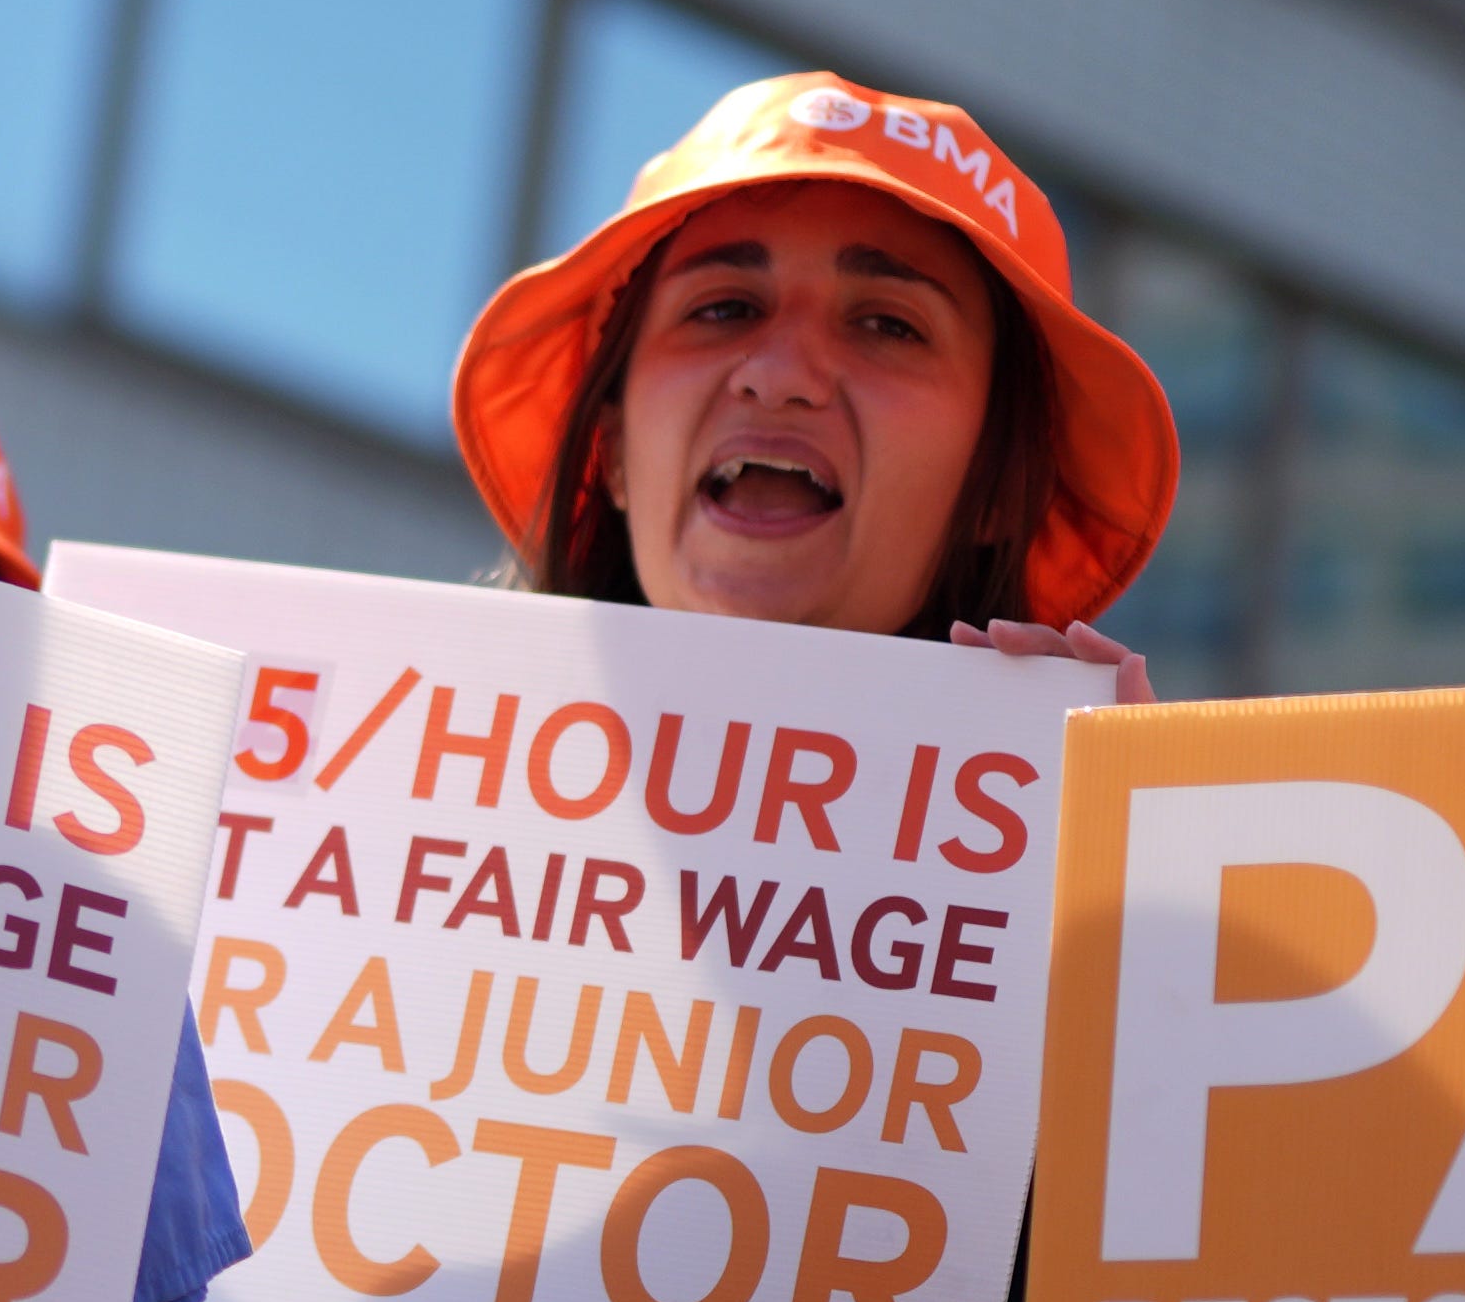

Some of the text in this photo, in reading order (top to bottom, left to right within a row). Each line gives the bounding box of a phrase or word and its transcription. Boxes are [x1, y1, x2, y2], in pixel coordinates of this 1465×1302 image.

[884, 107, 1018, 239] BMA
[4, 702, 157, 856] IS
[234, 666, 1041, 875] 5/HOUR IS
[283, 826, 360, 917] A
[395, 836, 646, 955] FAIR
[678, 869, 1011, 1003] WAGE
[308, 956, 408, 1074] A
[429, 970, 983, 1154] JUNIOR
